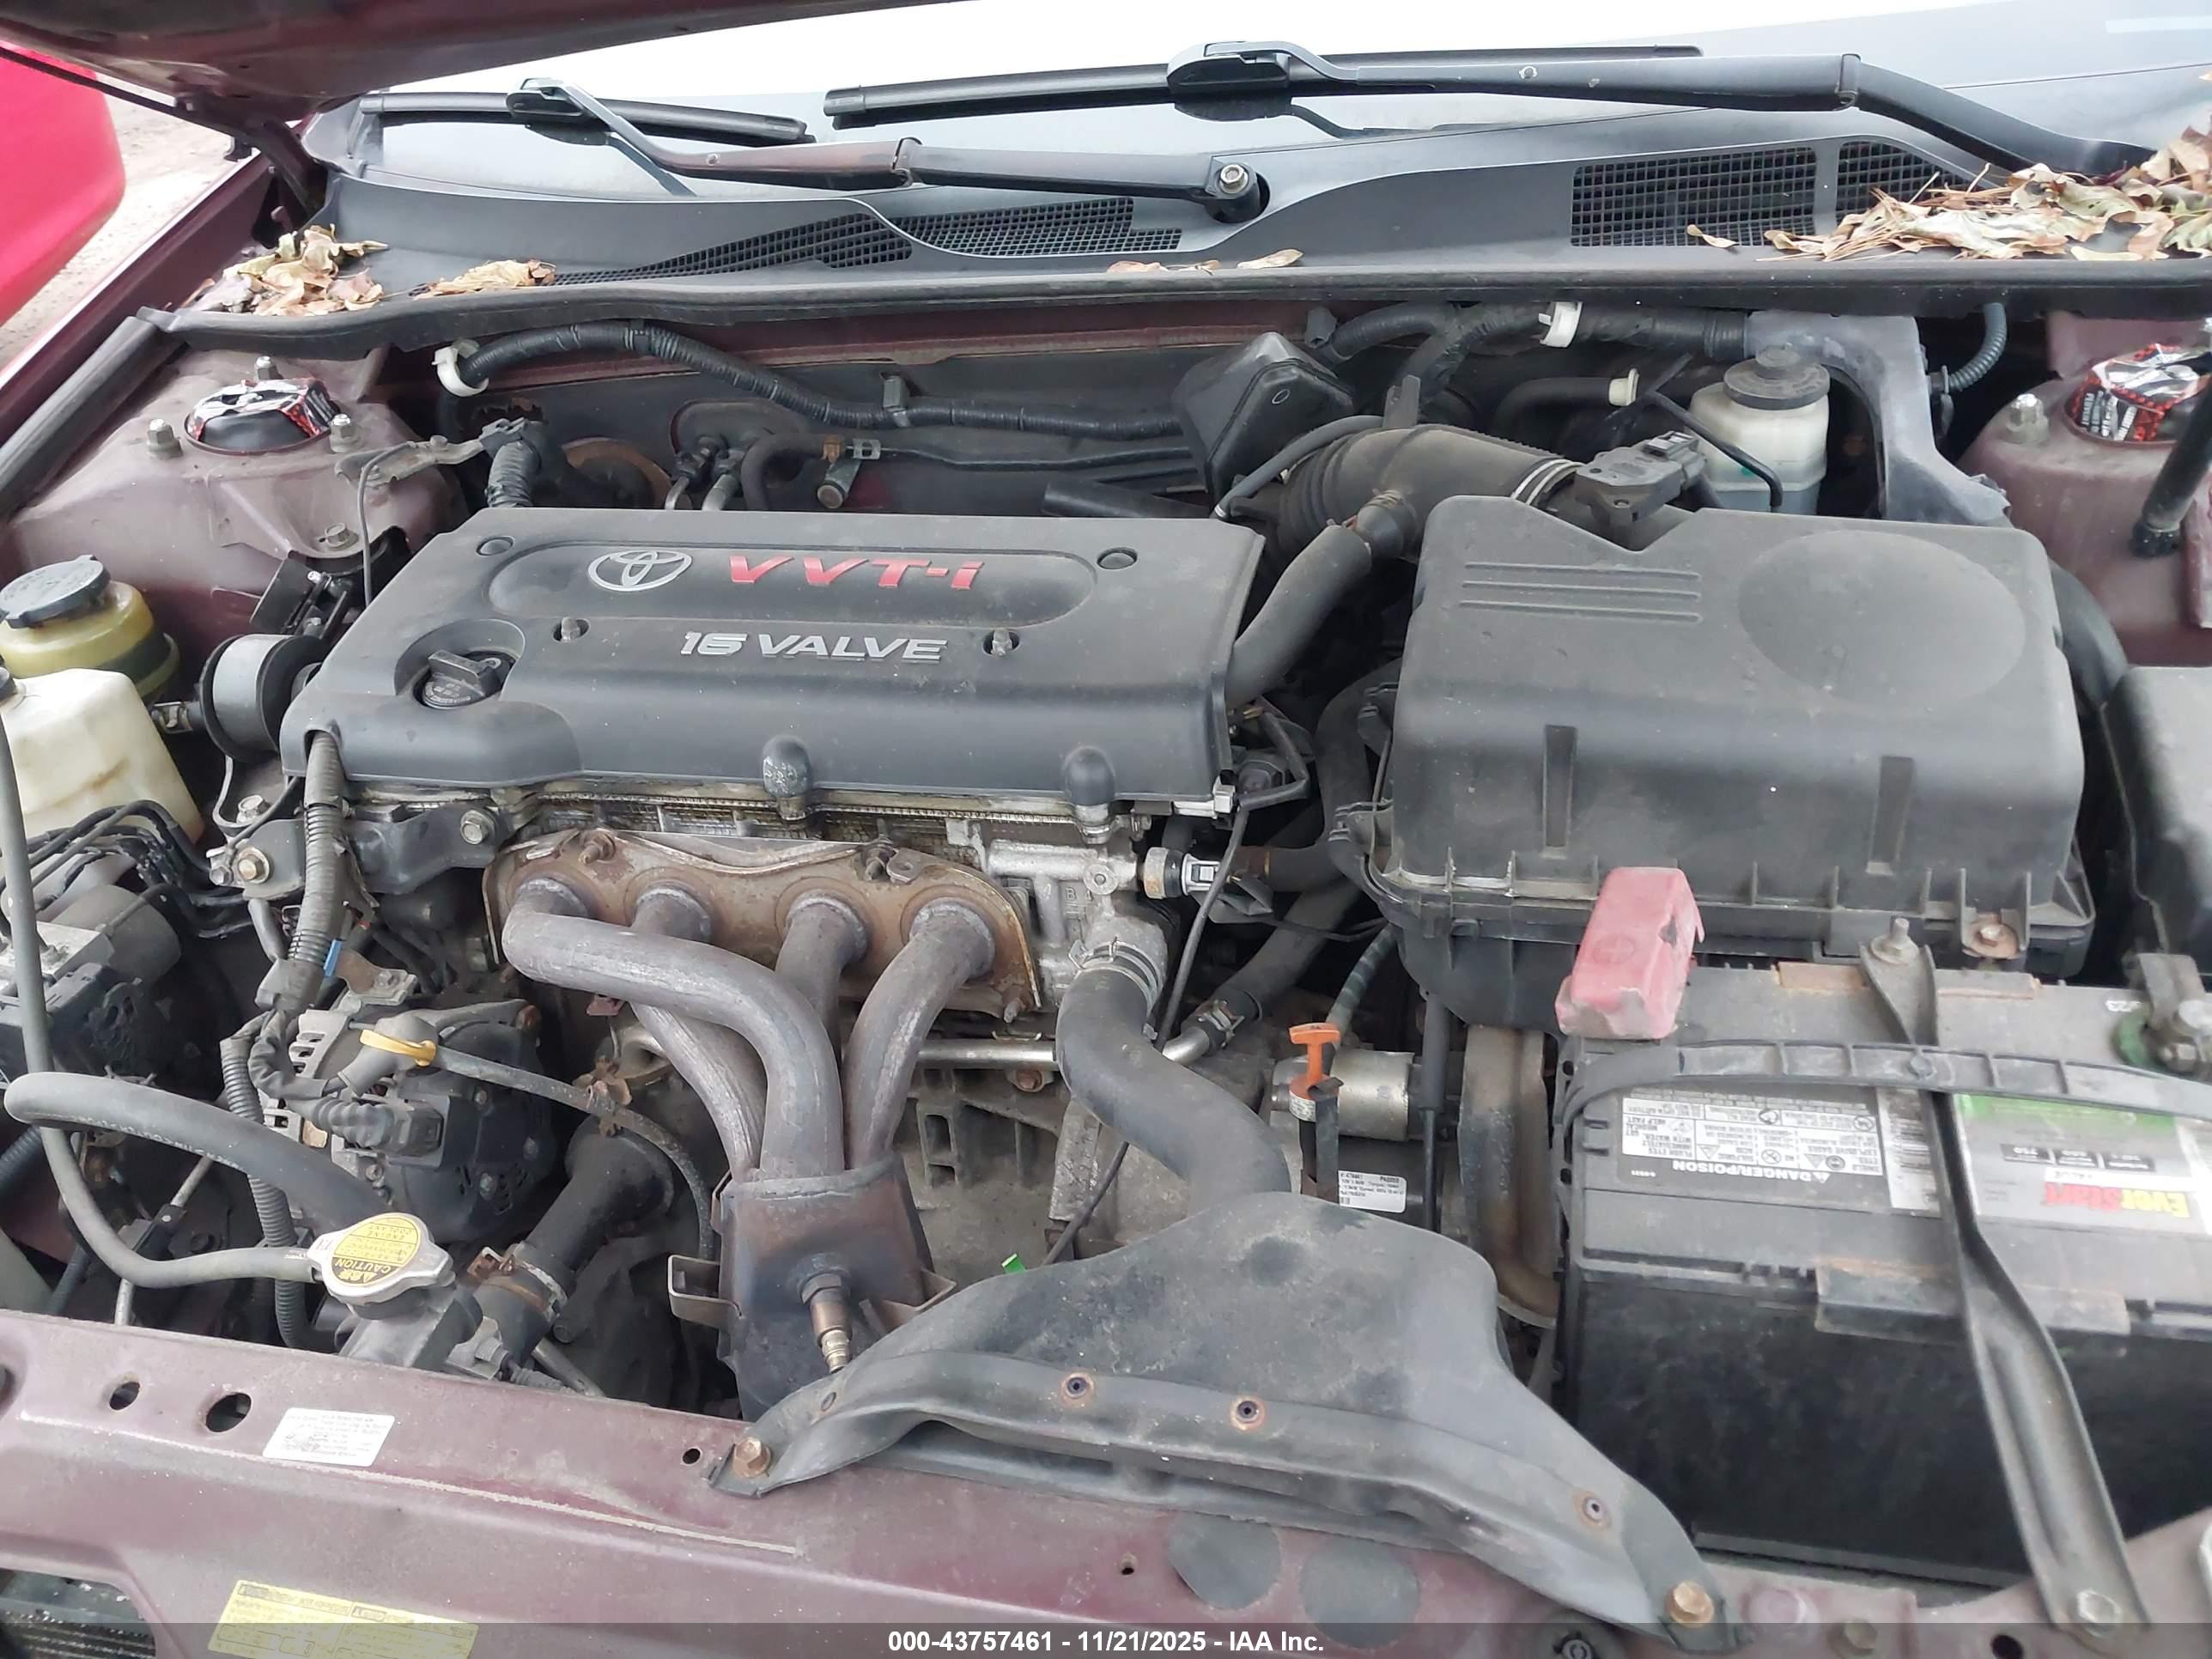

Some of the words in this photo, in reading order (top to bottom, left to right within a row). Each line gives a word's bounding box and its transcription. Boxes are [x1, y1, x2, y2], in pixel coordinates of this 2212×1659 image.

[729, 556, 984, 590] VVT-i
[681, 632, 749, 656] 16
[758, 634, 947, 662] VALVE
[1672, 1159, 1813, 1182] DANGER/POISON
[2044, 1182, 2191, 1218] EverStart
[334, 1258, 392, 1274] CAUTION
